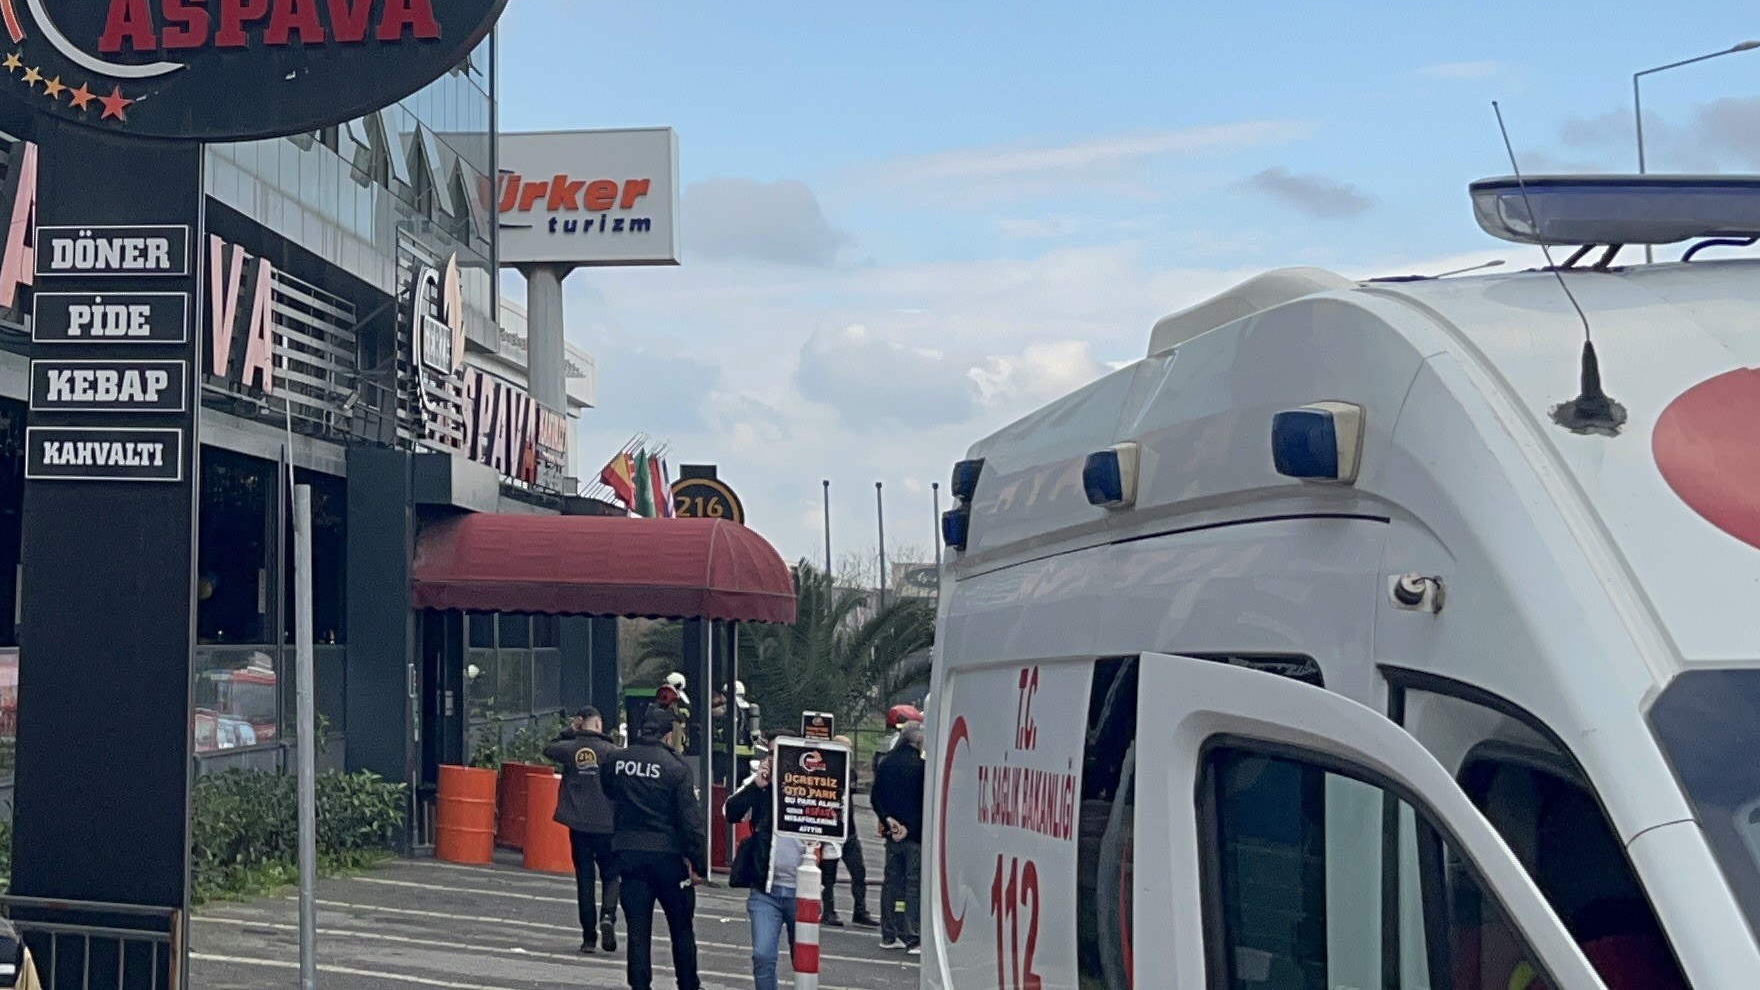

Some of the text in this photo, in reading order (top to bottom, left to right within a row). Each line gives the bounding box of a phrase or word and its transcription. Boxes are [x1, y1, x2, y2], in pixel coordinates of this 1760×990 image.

[548, 213, 652, 234] turizm
[50, 230, 170, 270] DÖNER
[67, 296, 151, 336] PİDE
[46, 369, 168, 402] KEBAP
[43, 442, 163, 466] KAHVALTI
[675, 496, 723, 518] 216
[1015, 665, 1038, 750] T.C.
[991, 854, 1042, 990] 112
